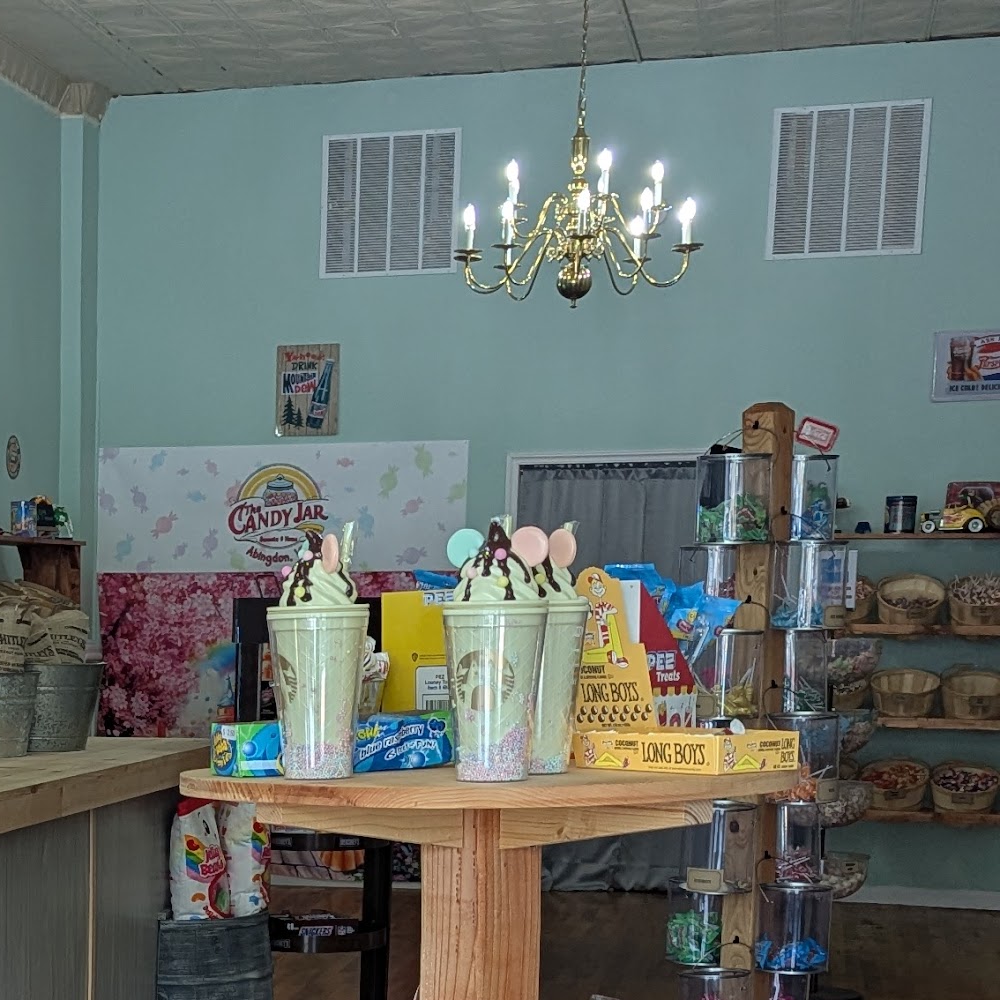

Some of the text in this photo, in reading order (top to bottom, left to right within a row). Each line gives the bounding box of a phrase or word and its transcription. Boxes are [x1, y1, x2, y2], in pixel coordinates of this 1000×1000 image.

[291, 361, 318, 371] DRINK
[228, 501, 329, 535] CANDY JAR
[648, 652, 676, 671] PEZ
[656, 671, 681, 683] Treats
[581, 682, 639, 702] LONG BOYS
[360, 739, 382, 760] blue
[383, 723, 425, 749] raspberry
[615, 739, 638, 747] COCONUT
[781, 738, 796, 749] LONG
[641, 742, 705, 765] LONG BOYS
[780, 751, 796, 763] BOYS
[299, 925, 334, 937] SNICKERS
